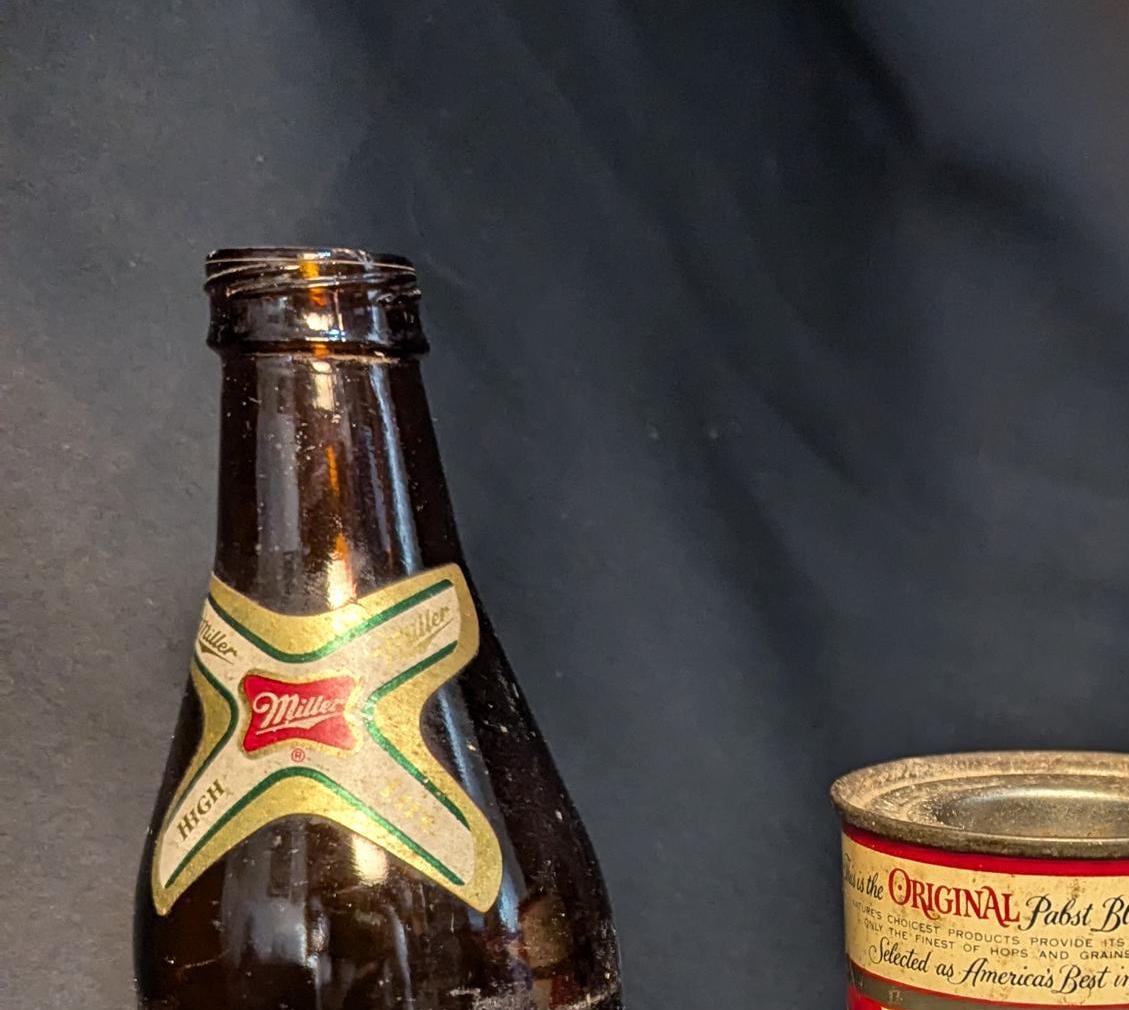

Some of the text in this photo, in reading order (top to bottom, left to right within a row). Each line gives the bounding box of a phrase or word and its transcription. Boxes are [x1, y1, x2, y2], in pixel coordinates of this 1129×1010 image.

[253, 691, 346, 730] Miller
[177, 778, 225, 840] HIGH
[866, 872, 884, 900] the
[888, 868, 1020, 928] ORIGINAL
[1018, 893, 1093, 931] Pabst
[864, 918, 883, 932] ONLY
[889, 927, 908, 940] THE
[915, 934, 955, 949] FINEST
[963, 943, 979, 953] OF
[990, 947, 1028, 958] HOPS
[1040, 950, 1069, 960] AND
[887, 914, 940, 934] CHOICEST
[948, 928, 1020, 945] PRODUCTS
[1031, 937, 1093, 948] PROVIDE
[1102, 938, 1125, 947] ITS
[869, 936, 932, 973] Selected
[936, 963, 954, 978] as
[950, 957, 1053, 989] America's
[1051, 964, 1112, 994] Best
